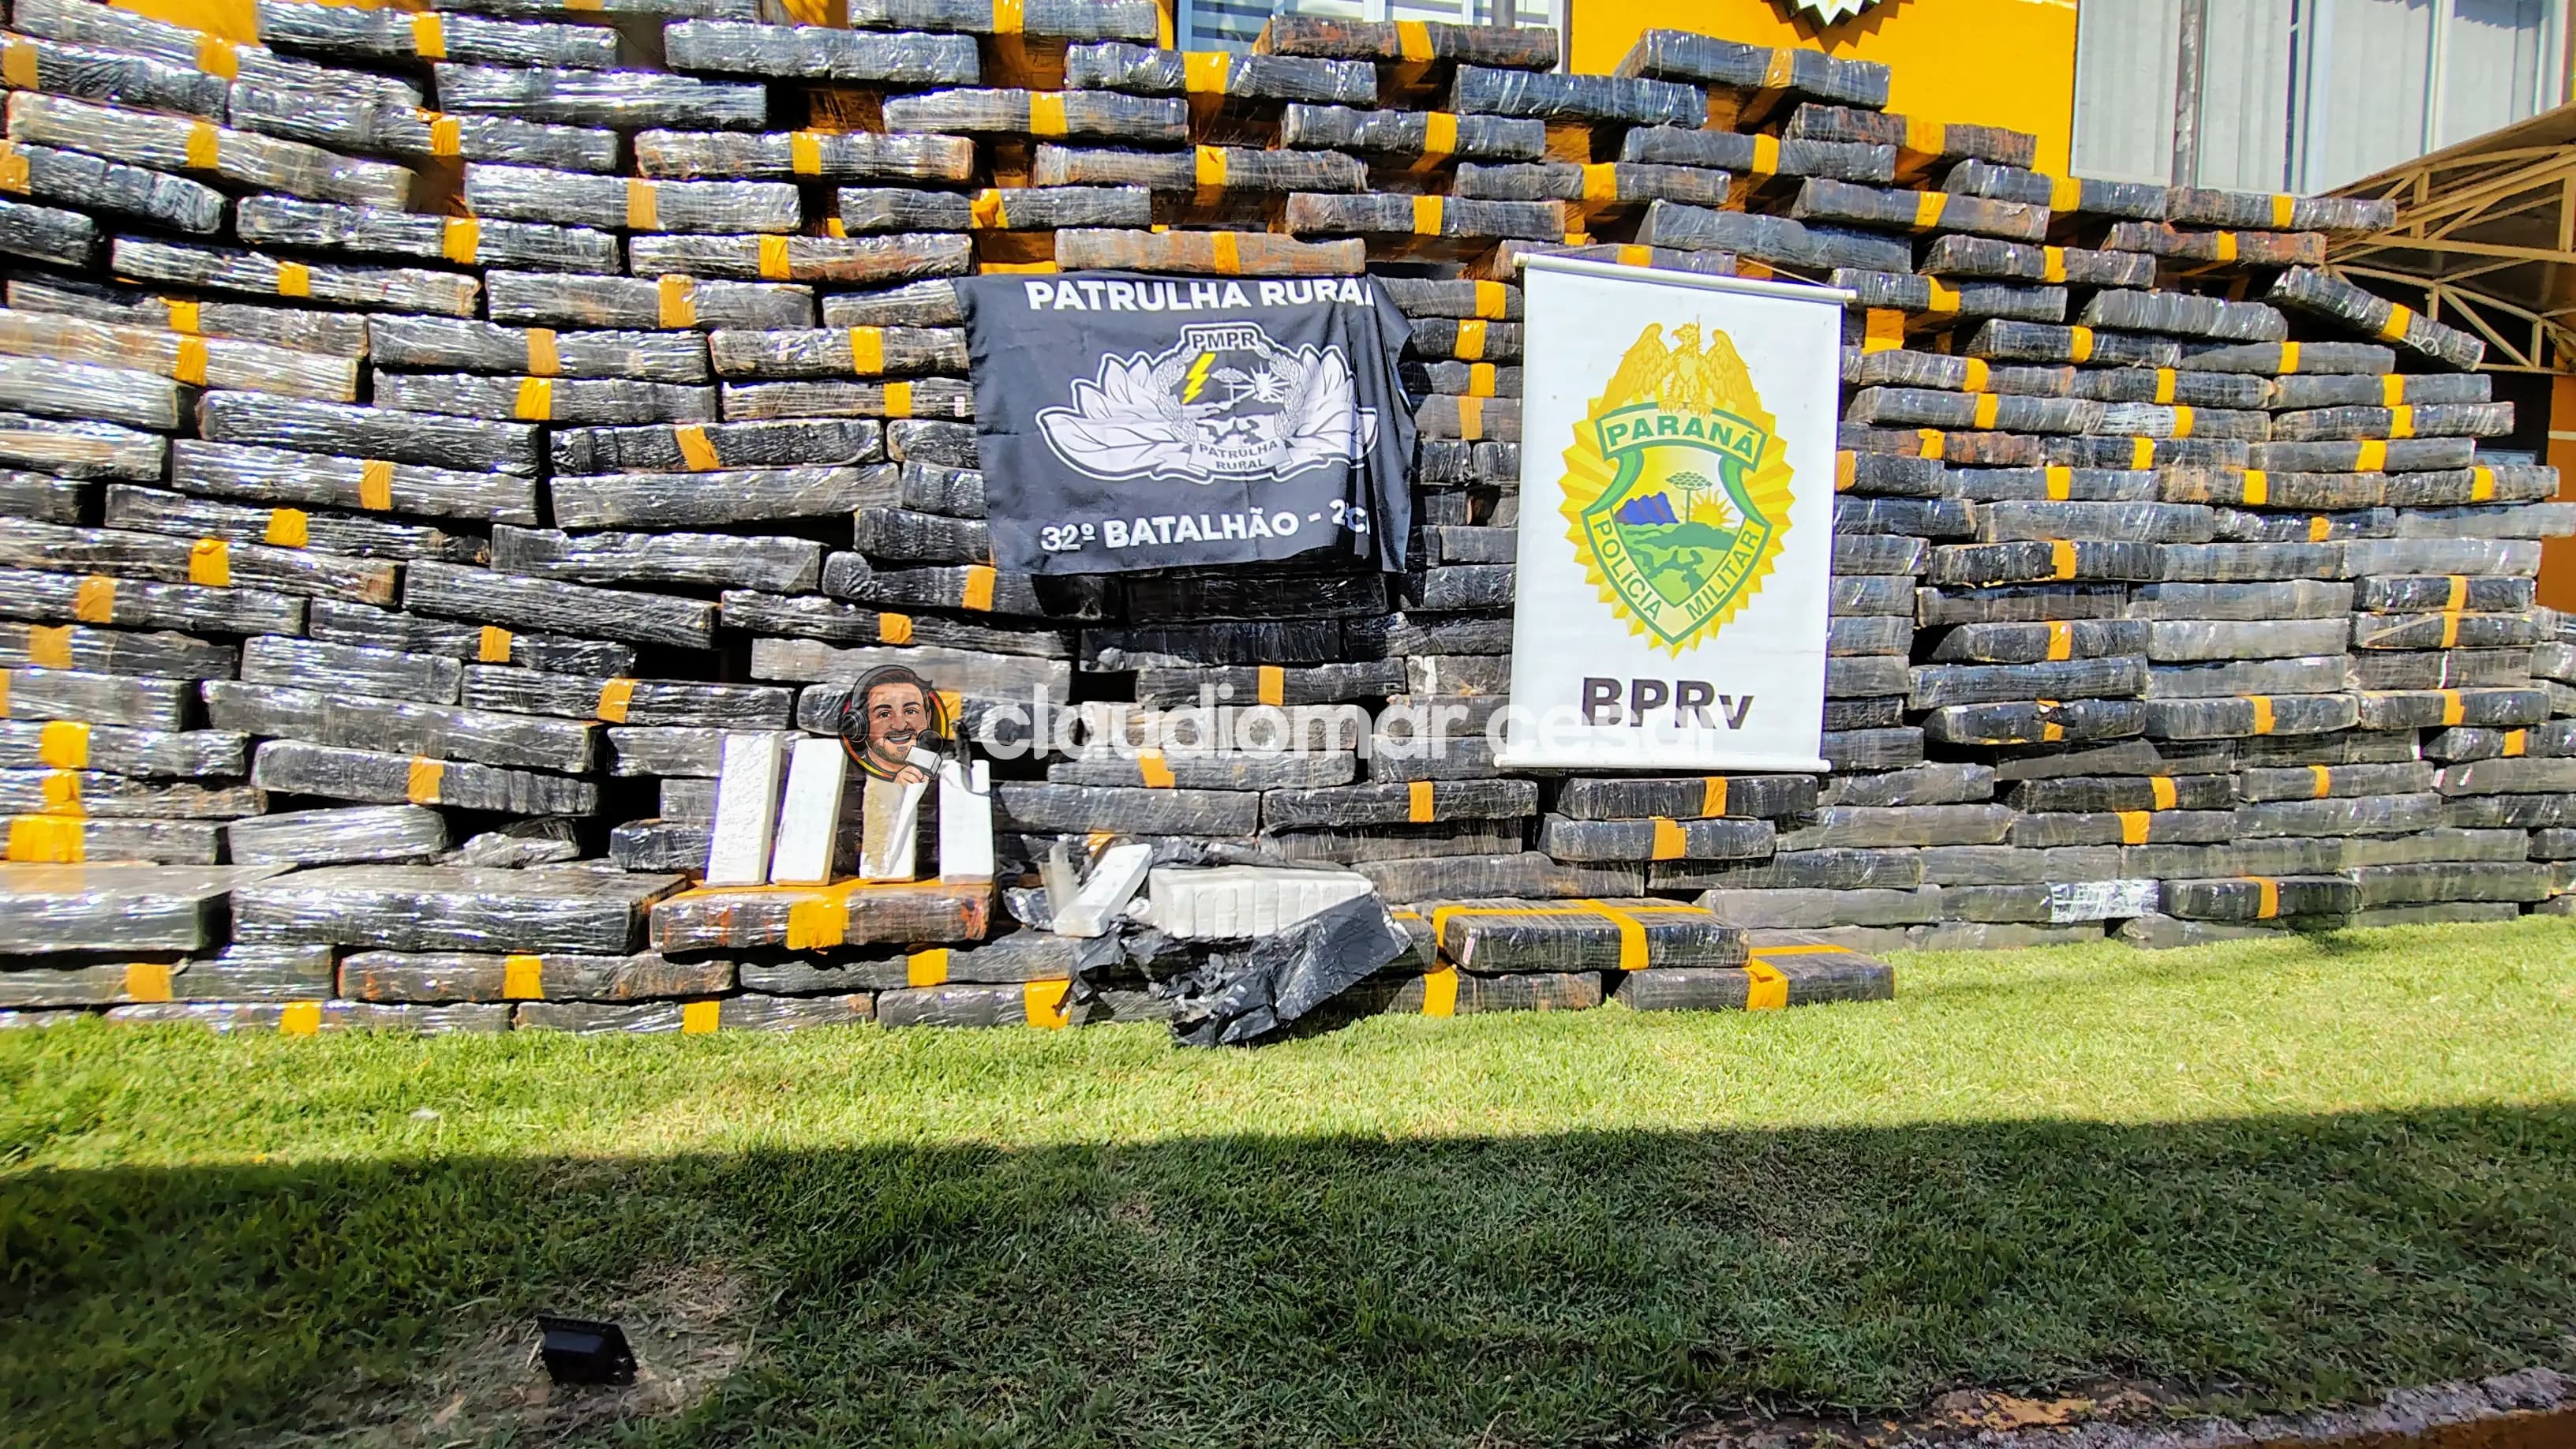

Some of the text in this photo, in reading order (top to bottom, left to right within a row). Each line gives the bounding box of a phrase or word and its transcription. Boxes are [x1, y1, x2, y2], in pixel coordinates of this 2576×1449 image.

[1024, 281, 1252, 311] PATRULHA
[1192, 331, 1257, 349] PMPR
[1199, 440, 1279, 459] PATRULHA
[1605, 415, 1756, 459] PARANÁ
[1215, 459, 1267, 470] RURAL
[1103, 507, 1300, 549] BATALHÃO
[1593, 519, 1663, 622] POLÍCIA
[1685, 530, 1760, 621] MILITAR
[1581, 676, 1755, 731] BPRv
